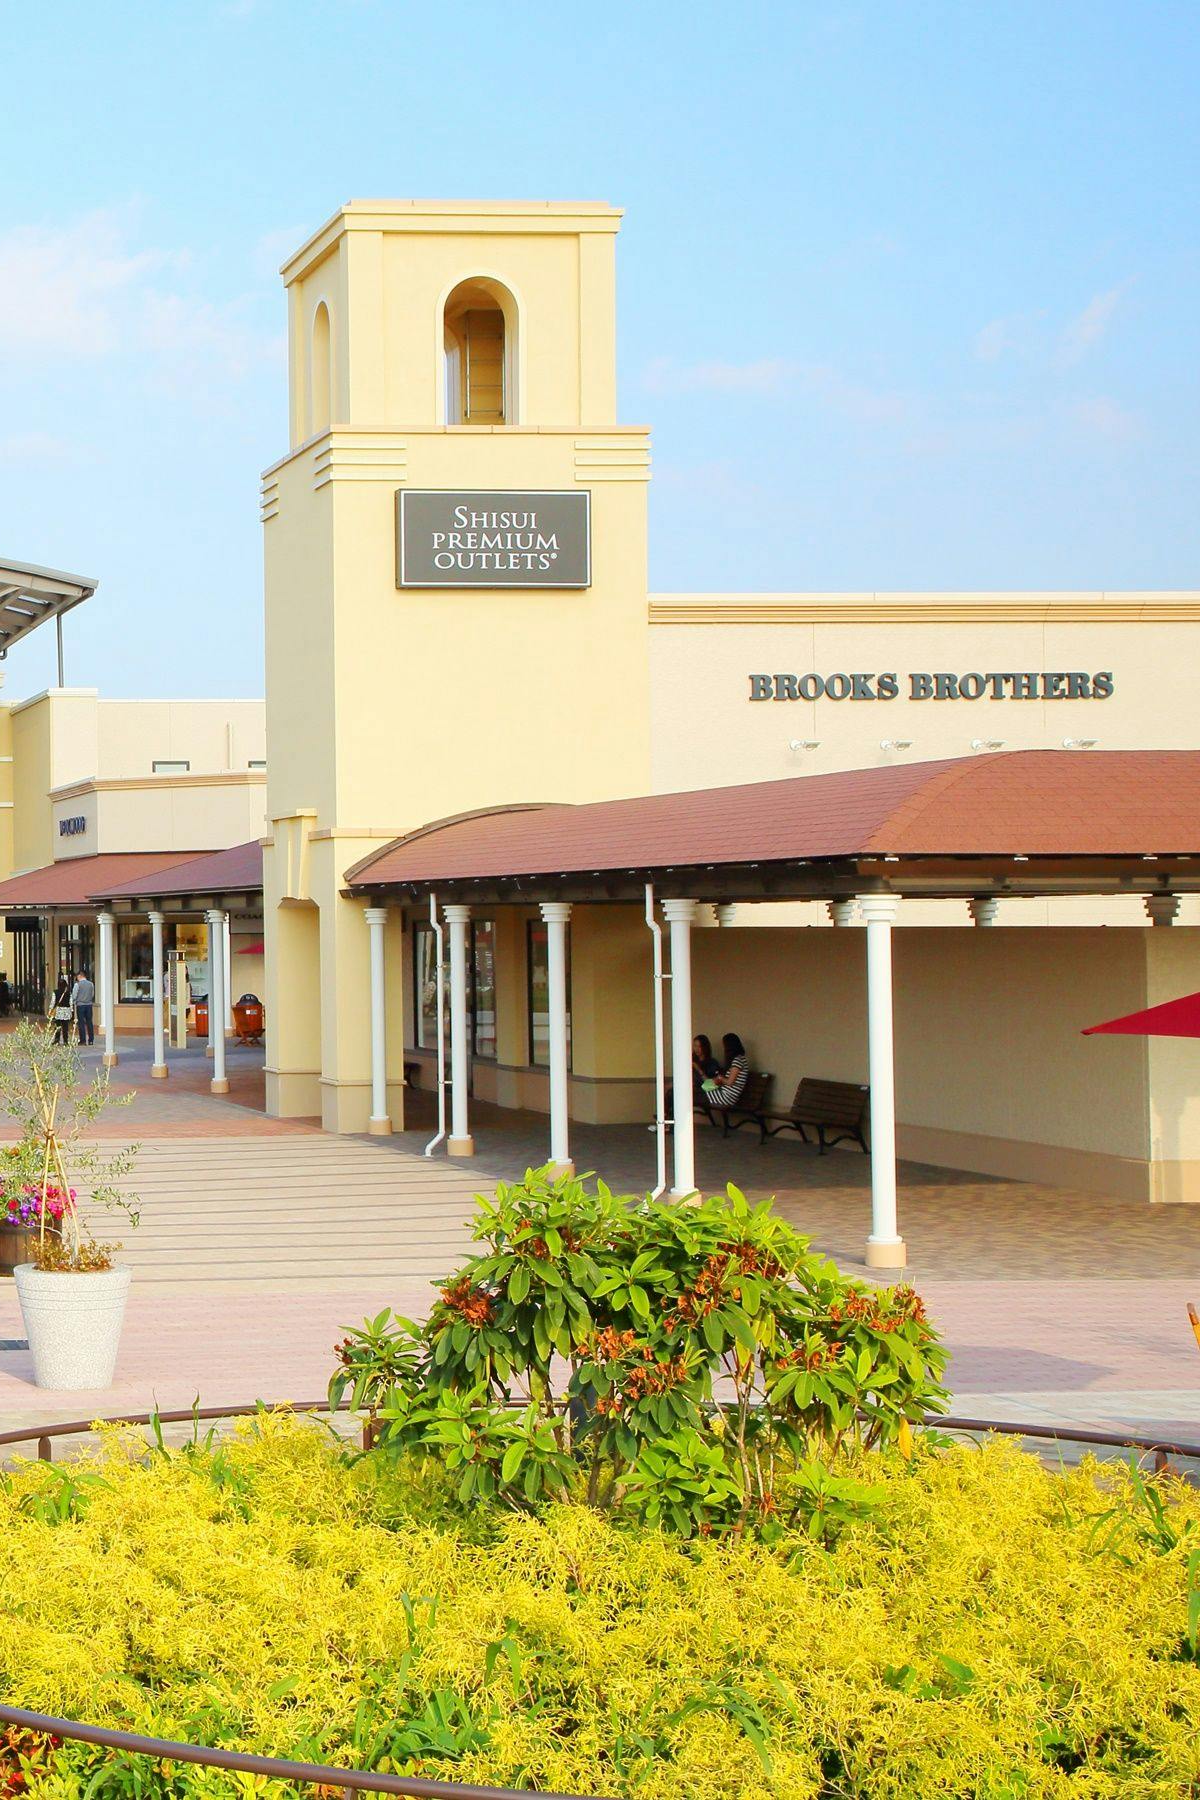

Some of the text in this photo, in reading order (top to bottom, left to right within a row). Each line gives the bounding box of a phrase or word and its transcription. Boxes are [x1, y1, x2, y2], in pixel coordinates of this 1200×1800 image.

[432, 532, 560, 550] PREMIUM
[749, 672, 1114, 701] BROOKS BROTHERS
